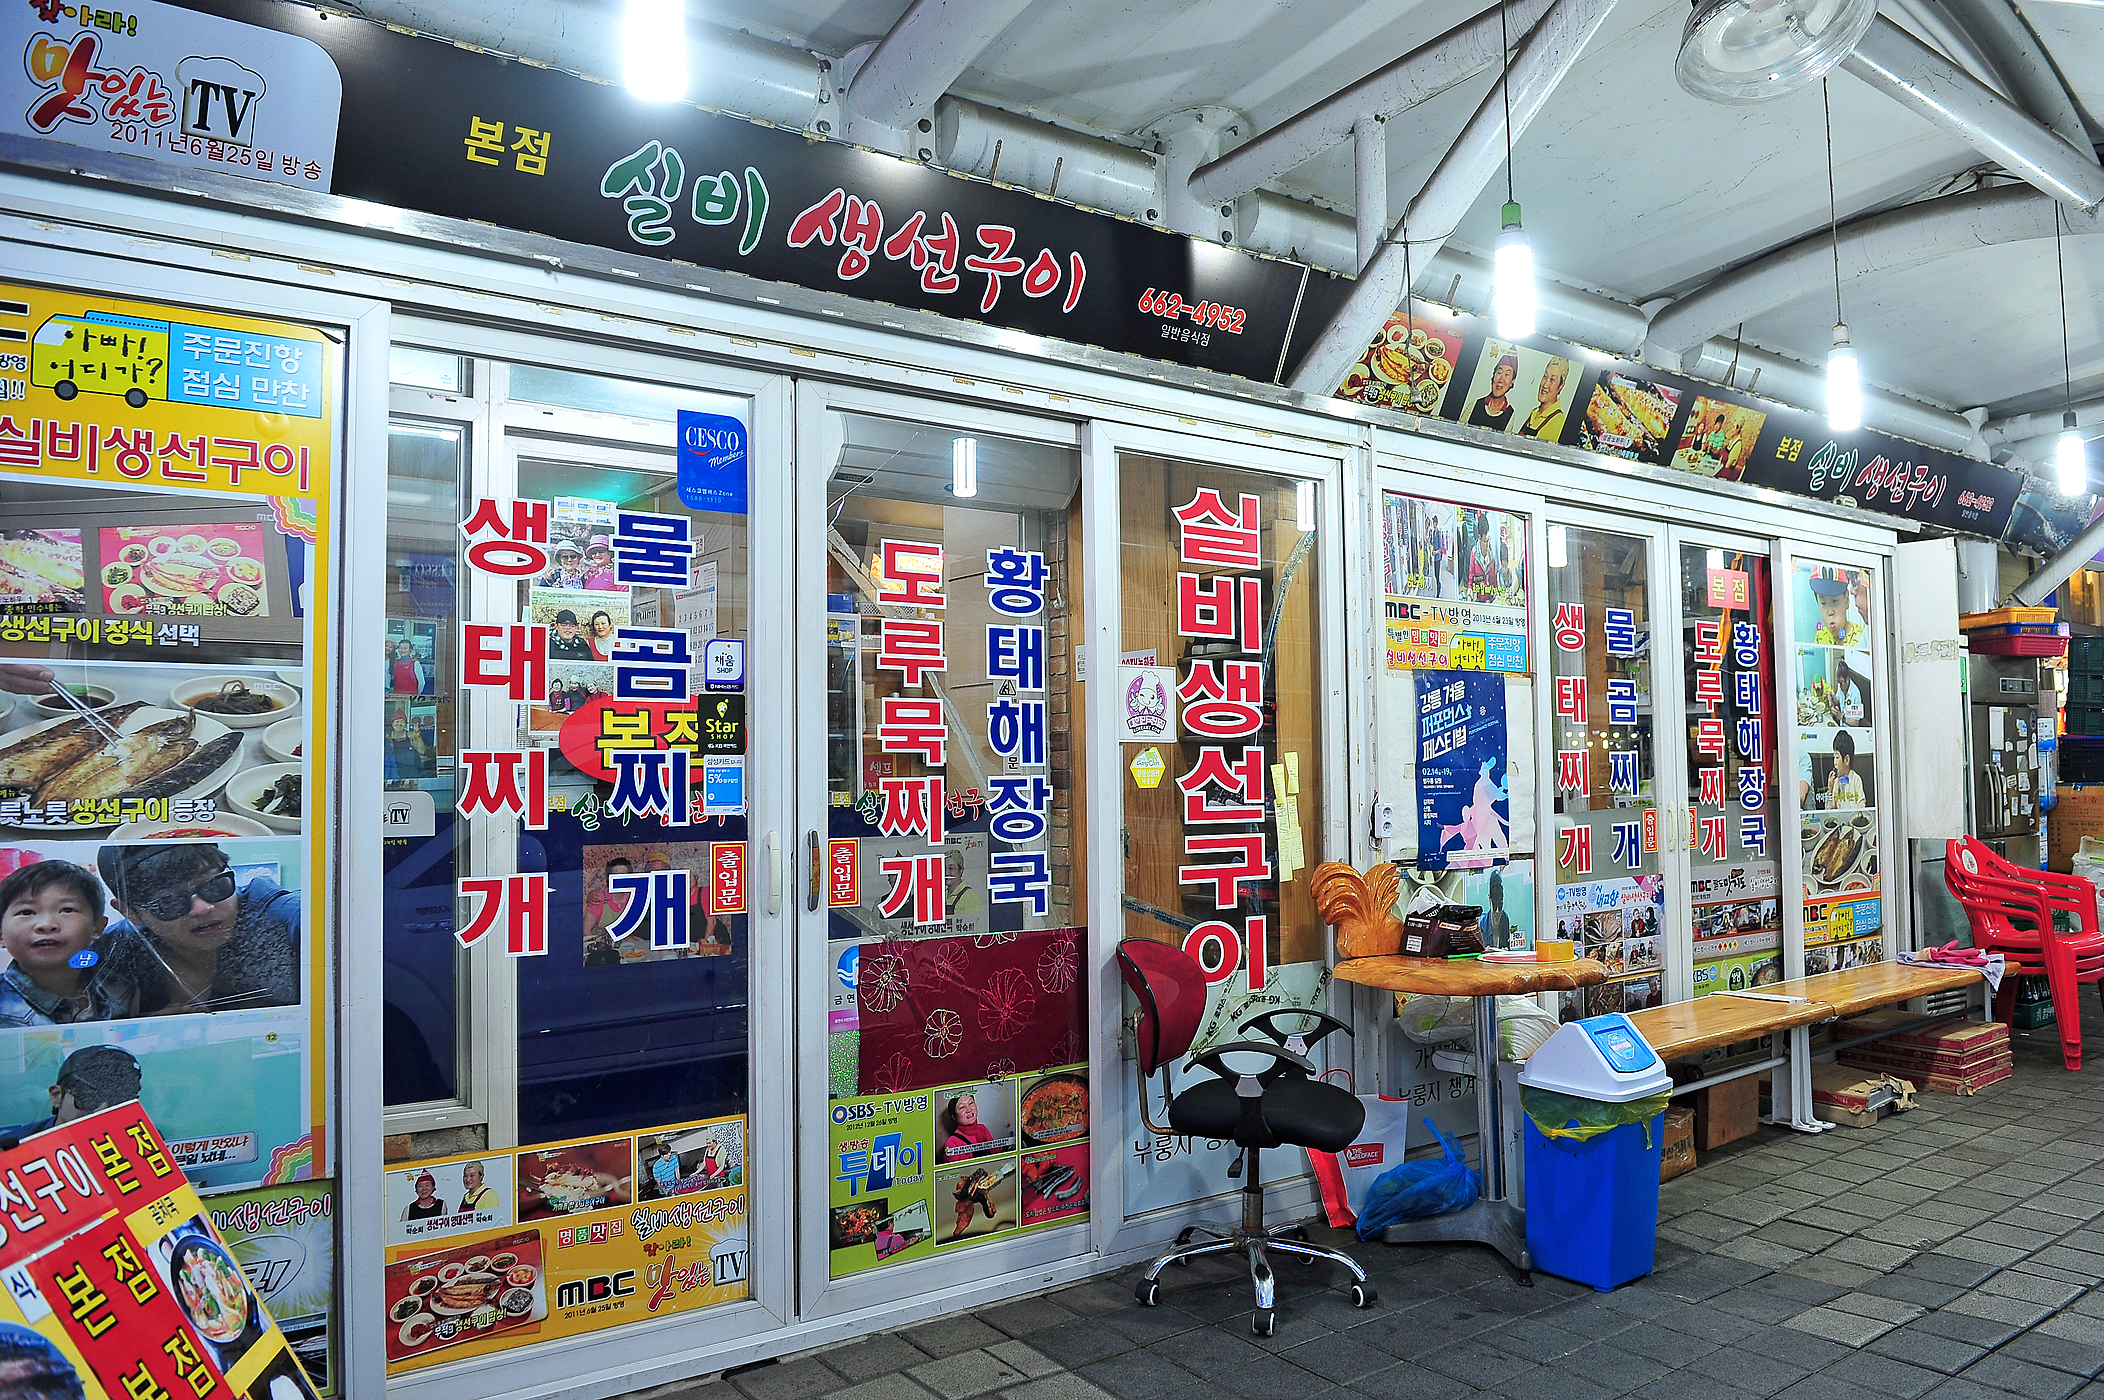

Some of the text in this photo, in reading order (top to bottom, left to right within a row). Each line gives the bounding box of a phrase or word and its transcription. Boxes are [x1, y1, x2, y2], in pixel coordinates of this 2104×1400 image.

[26, 31, 256, 139] 맛있는 TV
[463, 115, 551, 176] 본점
[281, 155, 323, 181] 방송
[600, 139, 1087, 314] 실비 생선구이
[1137, 286, 1248, 335] 662-4952
[65, 327, 147, 361] 아빠!
[1160, 323, 1212, 347] 일반음식점
[183, 332, 305, 374] 주문진항
[50, 357, 163, 385] 어디가?
[182, 368, 311, 409] 점심 만찬
[685, 425, 740, 451] CESCO
[1775, 435, 1805, 462] 본점
[0, 415, 309, 493] 실비생선구이
[707, 449, 745, 468] Members
[1808, 439, 1948, 511] 실비 생선구이
[1957, 489, 1995, 512] 662-4952
[693, 569, 700, 587] 7
[1711, 576, 1747, 605] 본점
[0, 614, 200, 648] 생선구이 정식 선택
[1472, 613, 1491, 623] 2013년
[1492, 616, 1501, 624] 6월
[1502, 617, 1514, 626] 23일
[1387, 627, 1448, 648] 특별한 명품맛집
[1488, 636, 1522, 651] 주문진항
[714, 652, 735, 668] 채움
[716, 666, 734, 675] SHOP
[1488, 652, 1525, 669] 점심 만찬
[1419, 679, 1465, 714] 강릉 겨울
[455, 495, 551, 958] 생태찌개
[605, 508, 698, 951] 물곰찌개
[705, 718, 740, 734] Star
[876, 537, 948, 927] 도루묵찌개
[983, 545, 1053, 917] 황태해장국
[1421, 702, 1473, 739] 퍼포먼스
[710, 733, 734, 741] SHOP
[1171, 486, 1271, 991] 실비생선구이
[1422, 724, 1467, 763] 페스티벌
[1552, 602, 1594, 874] 생태찌개
[1604, 607, 1642, 870] 물곰찌개
[1694, 619, 1728, 863] 도루묵찌개
[1733, 620, 1768, 857] 황태해장국
[706, 757, 731, 767] 삼성카드
[707, 773, 723, 785] 5%
[70, 797, 169, 824] 생선구이
[173, 798, 216, 823] 등장
[832, 791, 851, 808] 본점
[391, 808, 409, 823] TV
[945, 837, 962, 845] MBC
[716, 850, 741, 906] 출입문
[832, 846, 854, 900] 출입문
[1690, 880, 1712, 894] MBC
[1596, 888, 1620, 909] 내고향
[1206, 1020, 1219, 1038] KG
[1230, 1007, 1243, 1023] KG
[89, 1119, 173, 1196] 본점
[171, 1136, 249, 1155] 이렇게 맛있냐
[838, 1138, 870, 1153] 생방송
[835, 1140, 924, 1198] 투데이
[895, 1173, 924, 1187] Today
[148, 1196, 181, 1226] 곰치국
[228, 1193, 332, 1234] 생선구이
[427, 1215, 450, 1232] 생선구이
[669, 1194, 746, 1229] 생선구이
[557, 1217, 625, 1248] 명품맛집
[643, 1236, 692, 1257] 찾아라!
[53, 1232, 160, 1340] 본점
[556, 1268, 636, 1310] MBC
[644, 1249, 744, 1312] 맛있는 TV
[564, 1307, 586, 1319] 2011년
[586, 1306, 597, 1315] 6월
[597, 1303, 612, 1313] 25일
